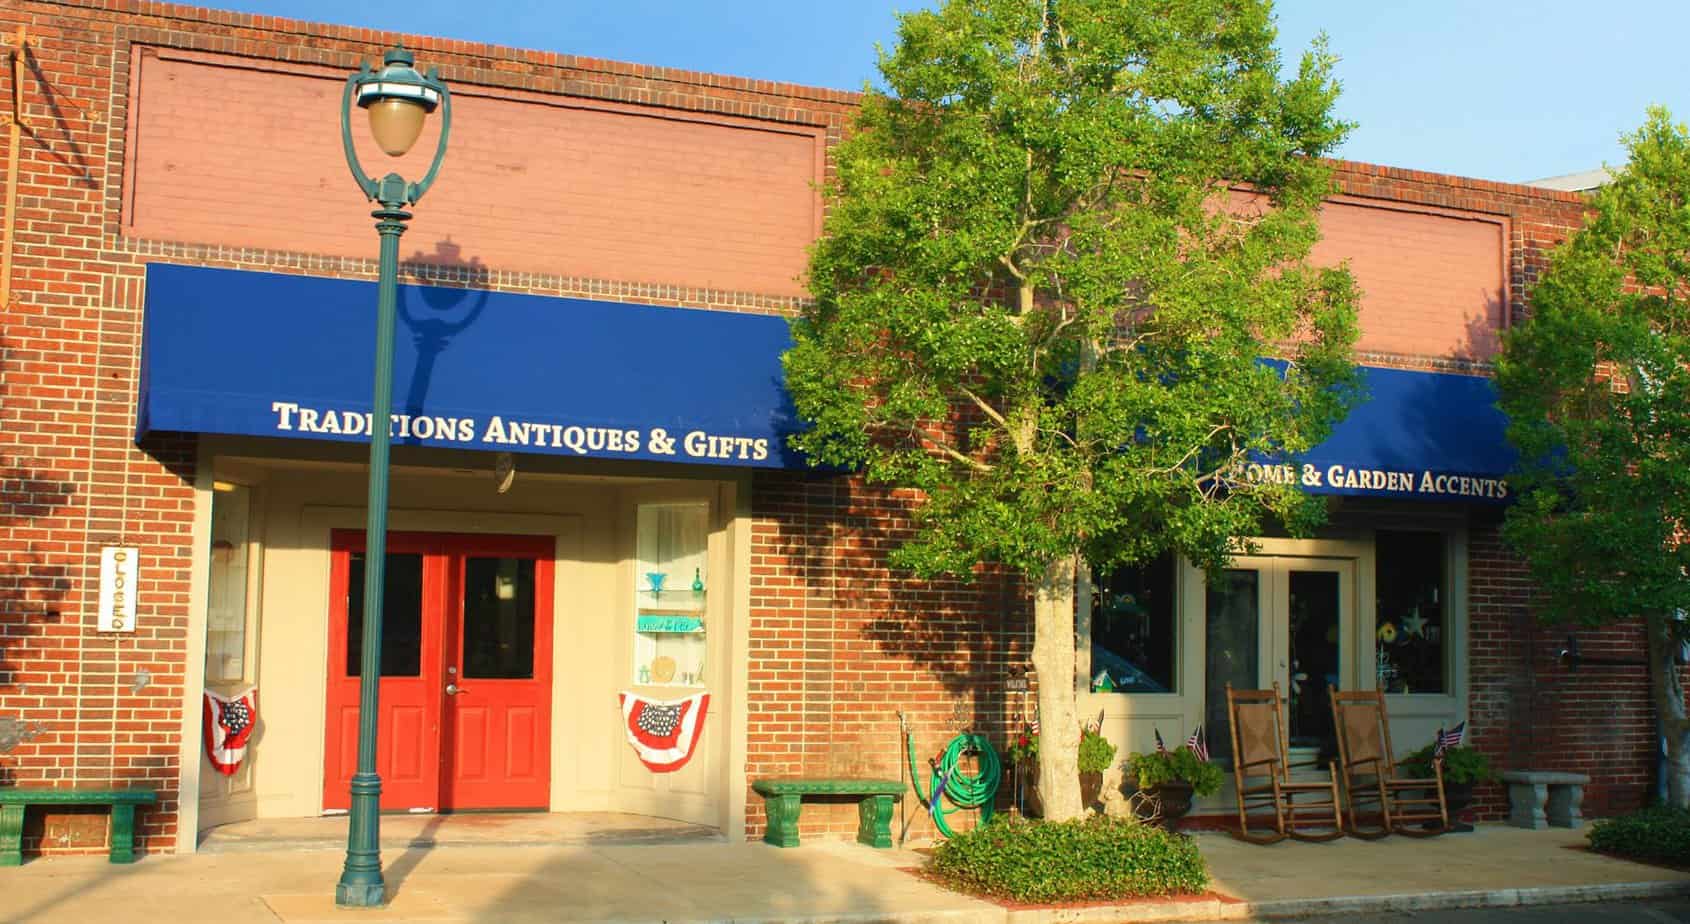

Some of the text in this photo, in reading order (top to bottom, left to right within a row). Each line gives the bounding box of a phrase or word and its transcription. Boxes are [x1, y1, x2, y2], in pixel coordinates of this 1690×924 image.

[482, 415, 640, 454] ANTIQUES
[648, 428, 676, 455] &
[684, 431, 769, 460] GIFTS
[1240, 463, 1508, 499] OME & GARDEN ACCENTS
